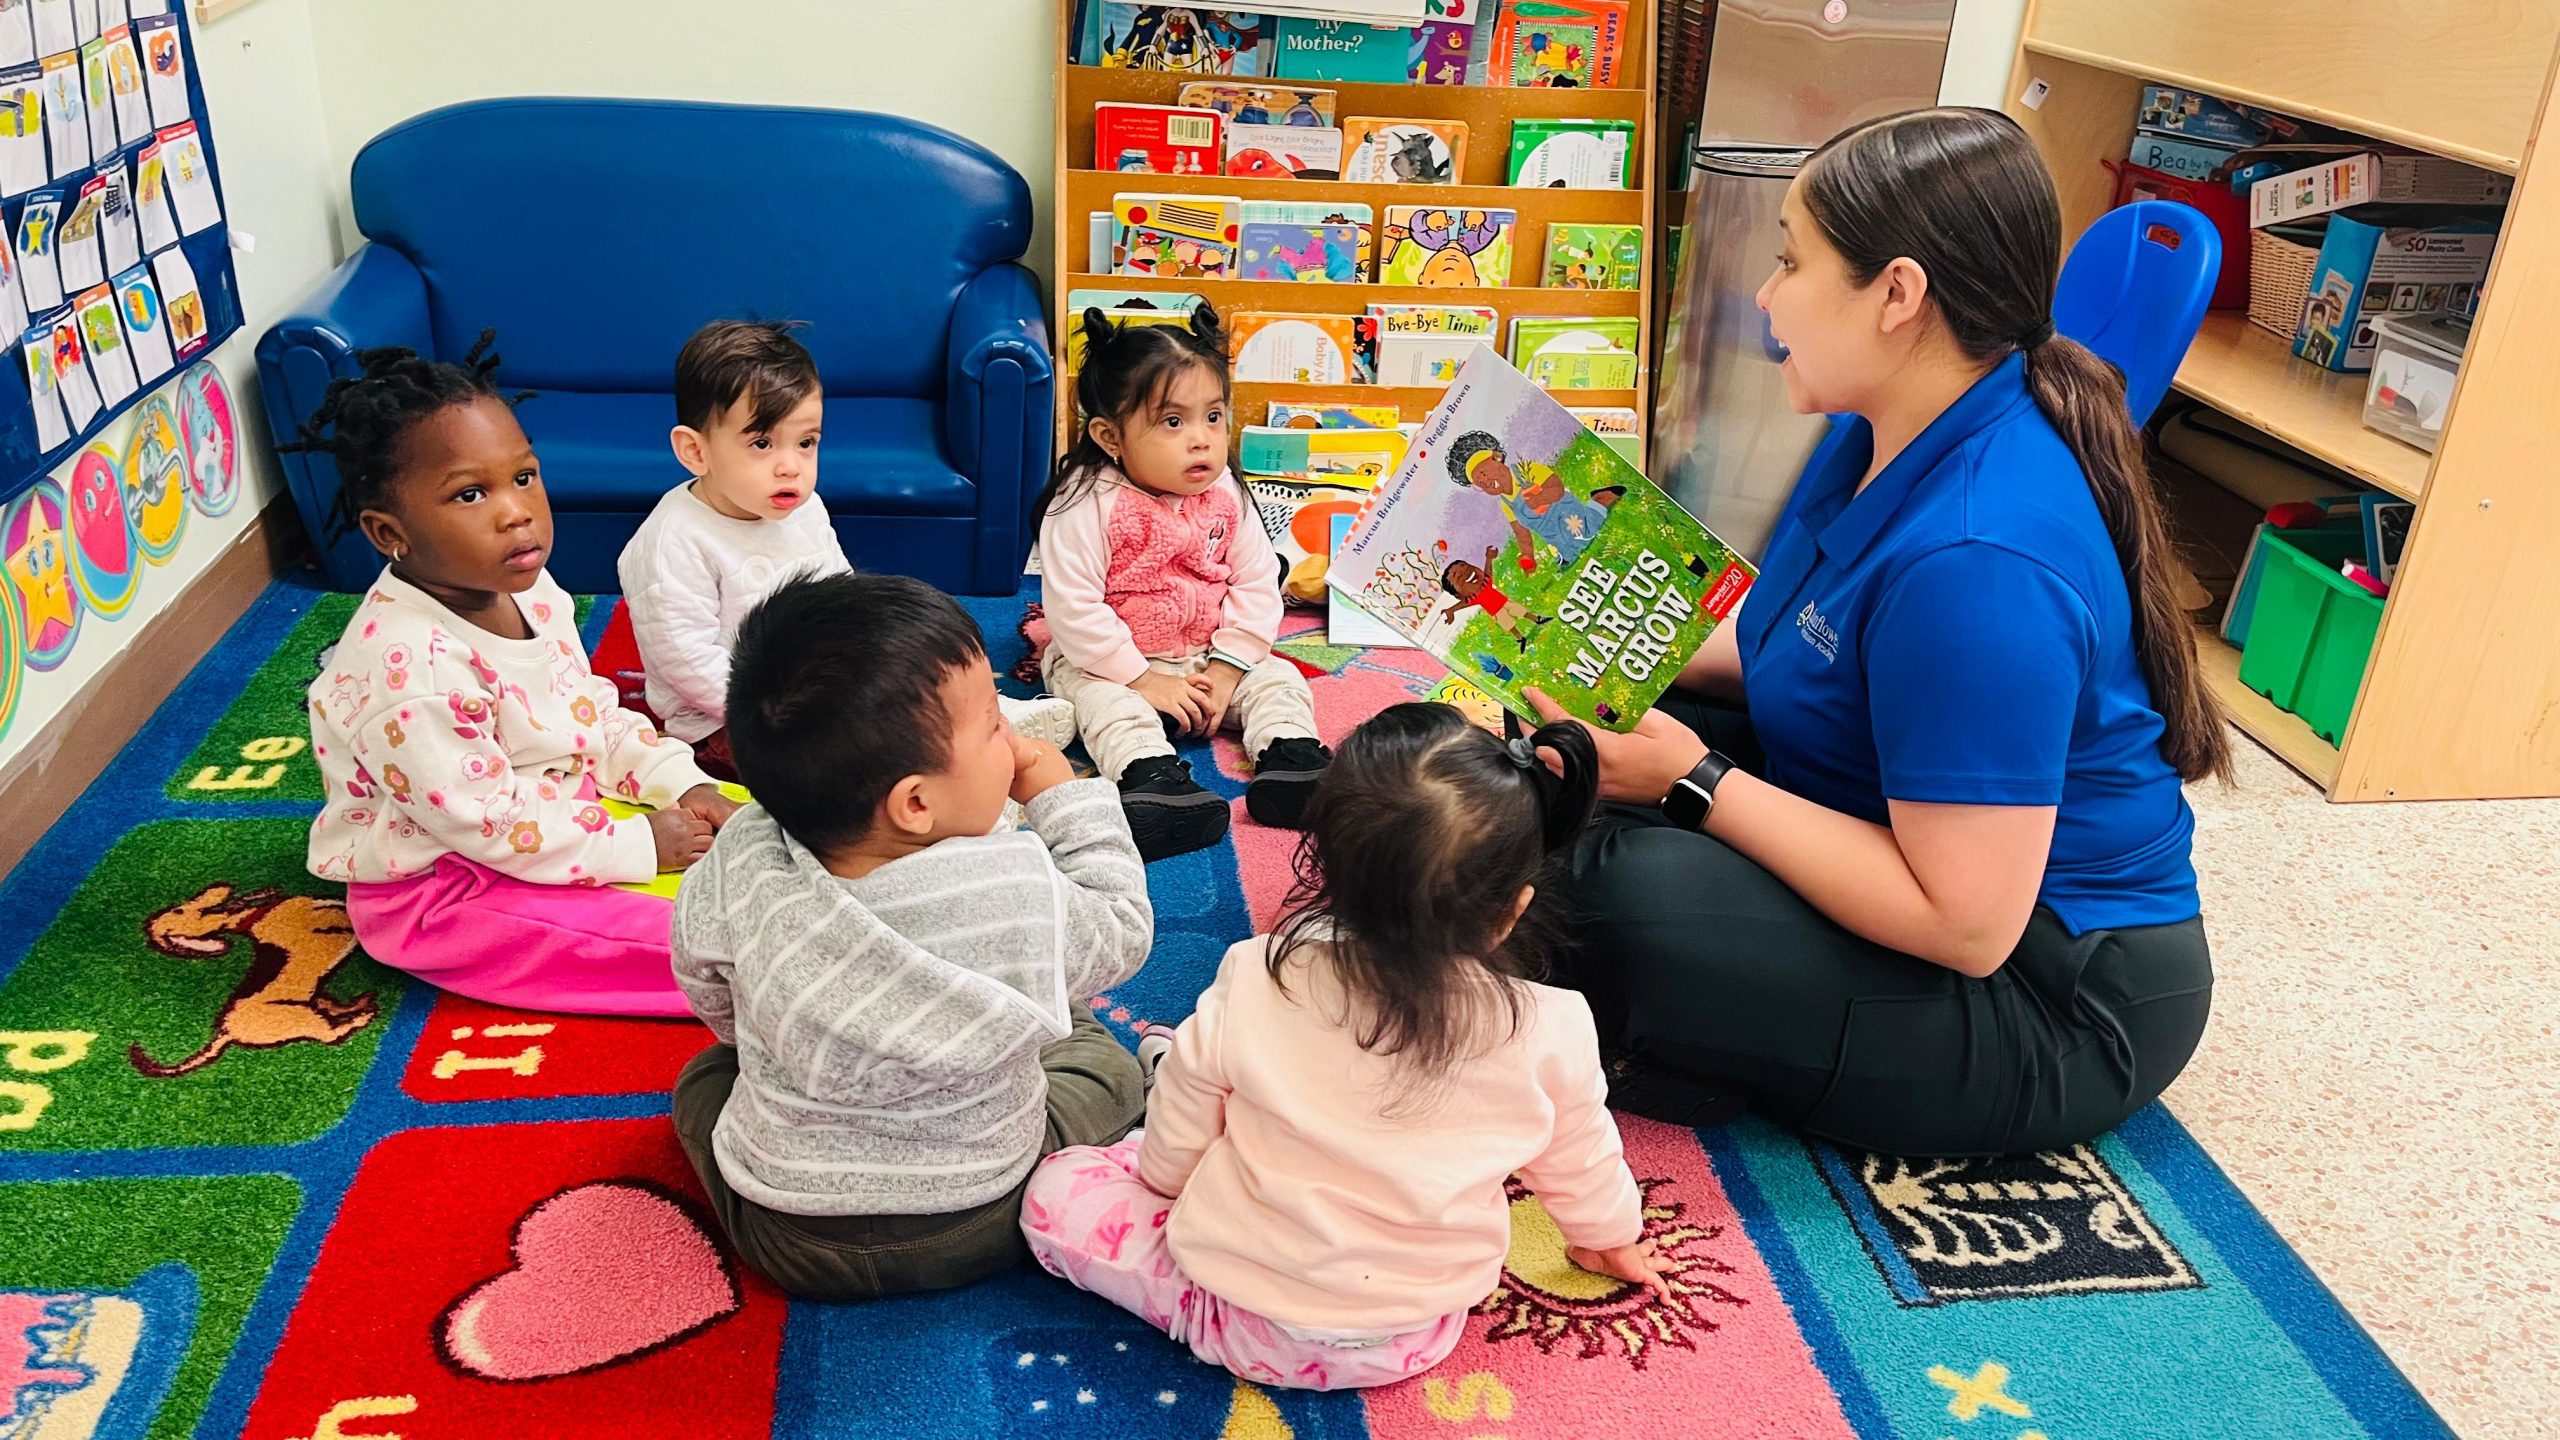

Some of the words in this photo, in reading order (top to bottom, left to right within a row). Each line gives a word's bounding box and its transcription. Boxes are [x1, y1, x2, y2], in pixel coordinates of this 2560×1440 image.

[1286, 34, 1364, 54] Mother?
[1604, 12, 1618, 54] BEAR'S
[1599, 56, 1612, 86] BUSY
[2148, 146, 2187, 170] Bea
[2405, 237, 2427, 252] 50
[1388, 314, 1439, 333] Bye-Bye
[1448, 314, 1479, 334] Time
[1352, 519, 1381, 556] Marcus
[1376, 463, 1419, 520] Bridgewater
[1425, 414, 1451, 447] Reggie
[1446, 383, 1471, 414] Brown
[1557, 557, 1619, 633] SEE
[1565, 548, 1672, 689] MARCUS
[1617, 583, 1693, 682] GROW
[186, 735, 307, 791] Ee
